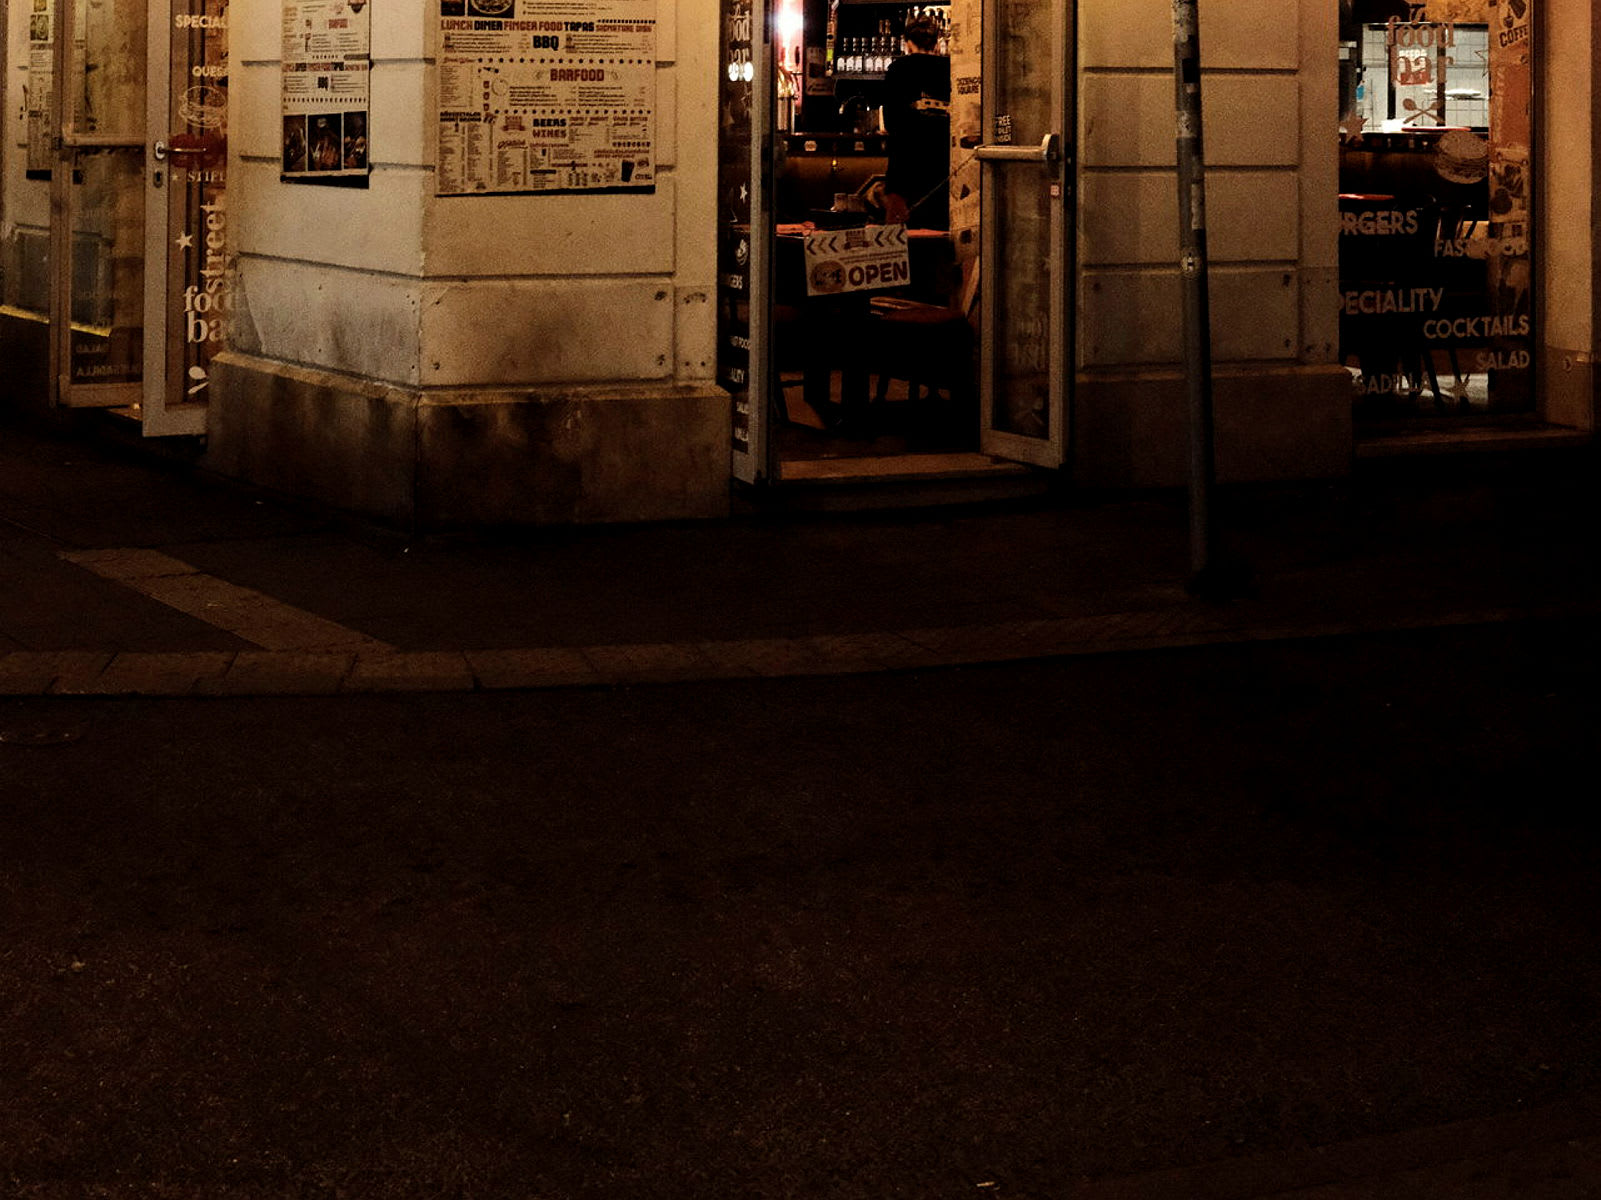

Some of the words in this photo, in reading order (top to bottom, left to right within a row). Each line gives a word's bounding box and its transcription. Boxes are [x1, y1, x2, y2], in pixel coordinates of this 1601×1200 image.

[441, 20, 473, 31] LUNCH
[504, 21, 537, 31] FINGER
[539, 21, 563, 31] FOOD
[564, 21, 595, 32] TAPAS
[1386, 15, 1455, 49] food
[533, 35, 559, 51] BBQ
[533, 118, 567, 127] BEERS
[533, 129, 567, 138] WINES
[200, 198, 227, 294] street
[848, 261, 908, 287] OPEN
[1423, 314, 1531, 340] COCKTAILS
[1475, 350, 1531, 372] SALAD
